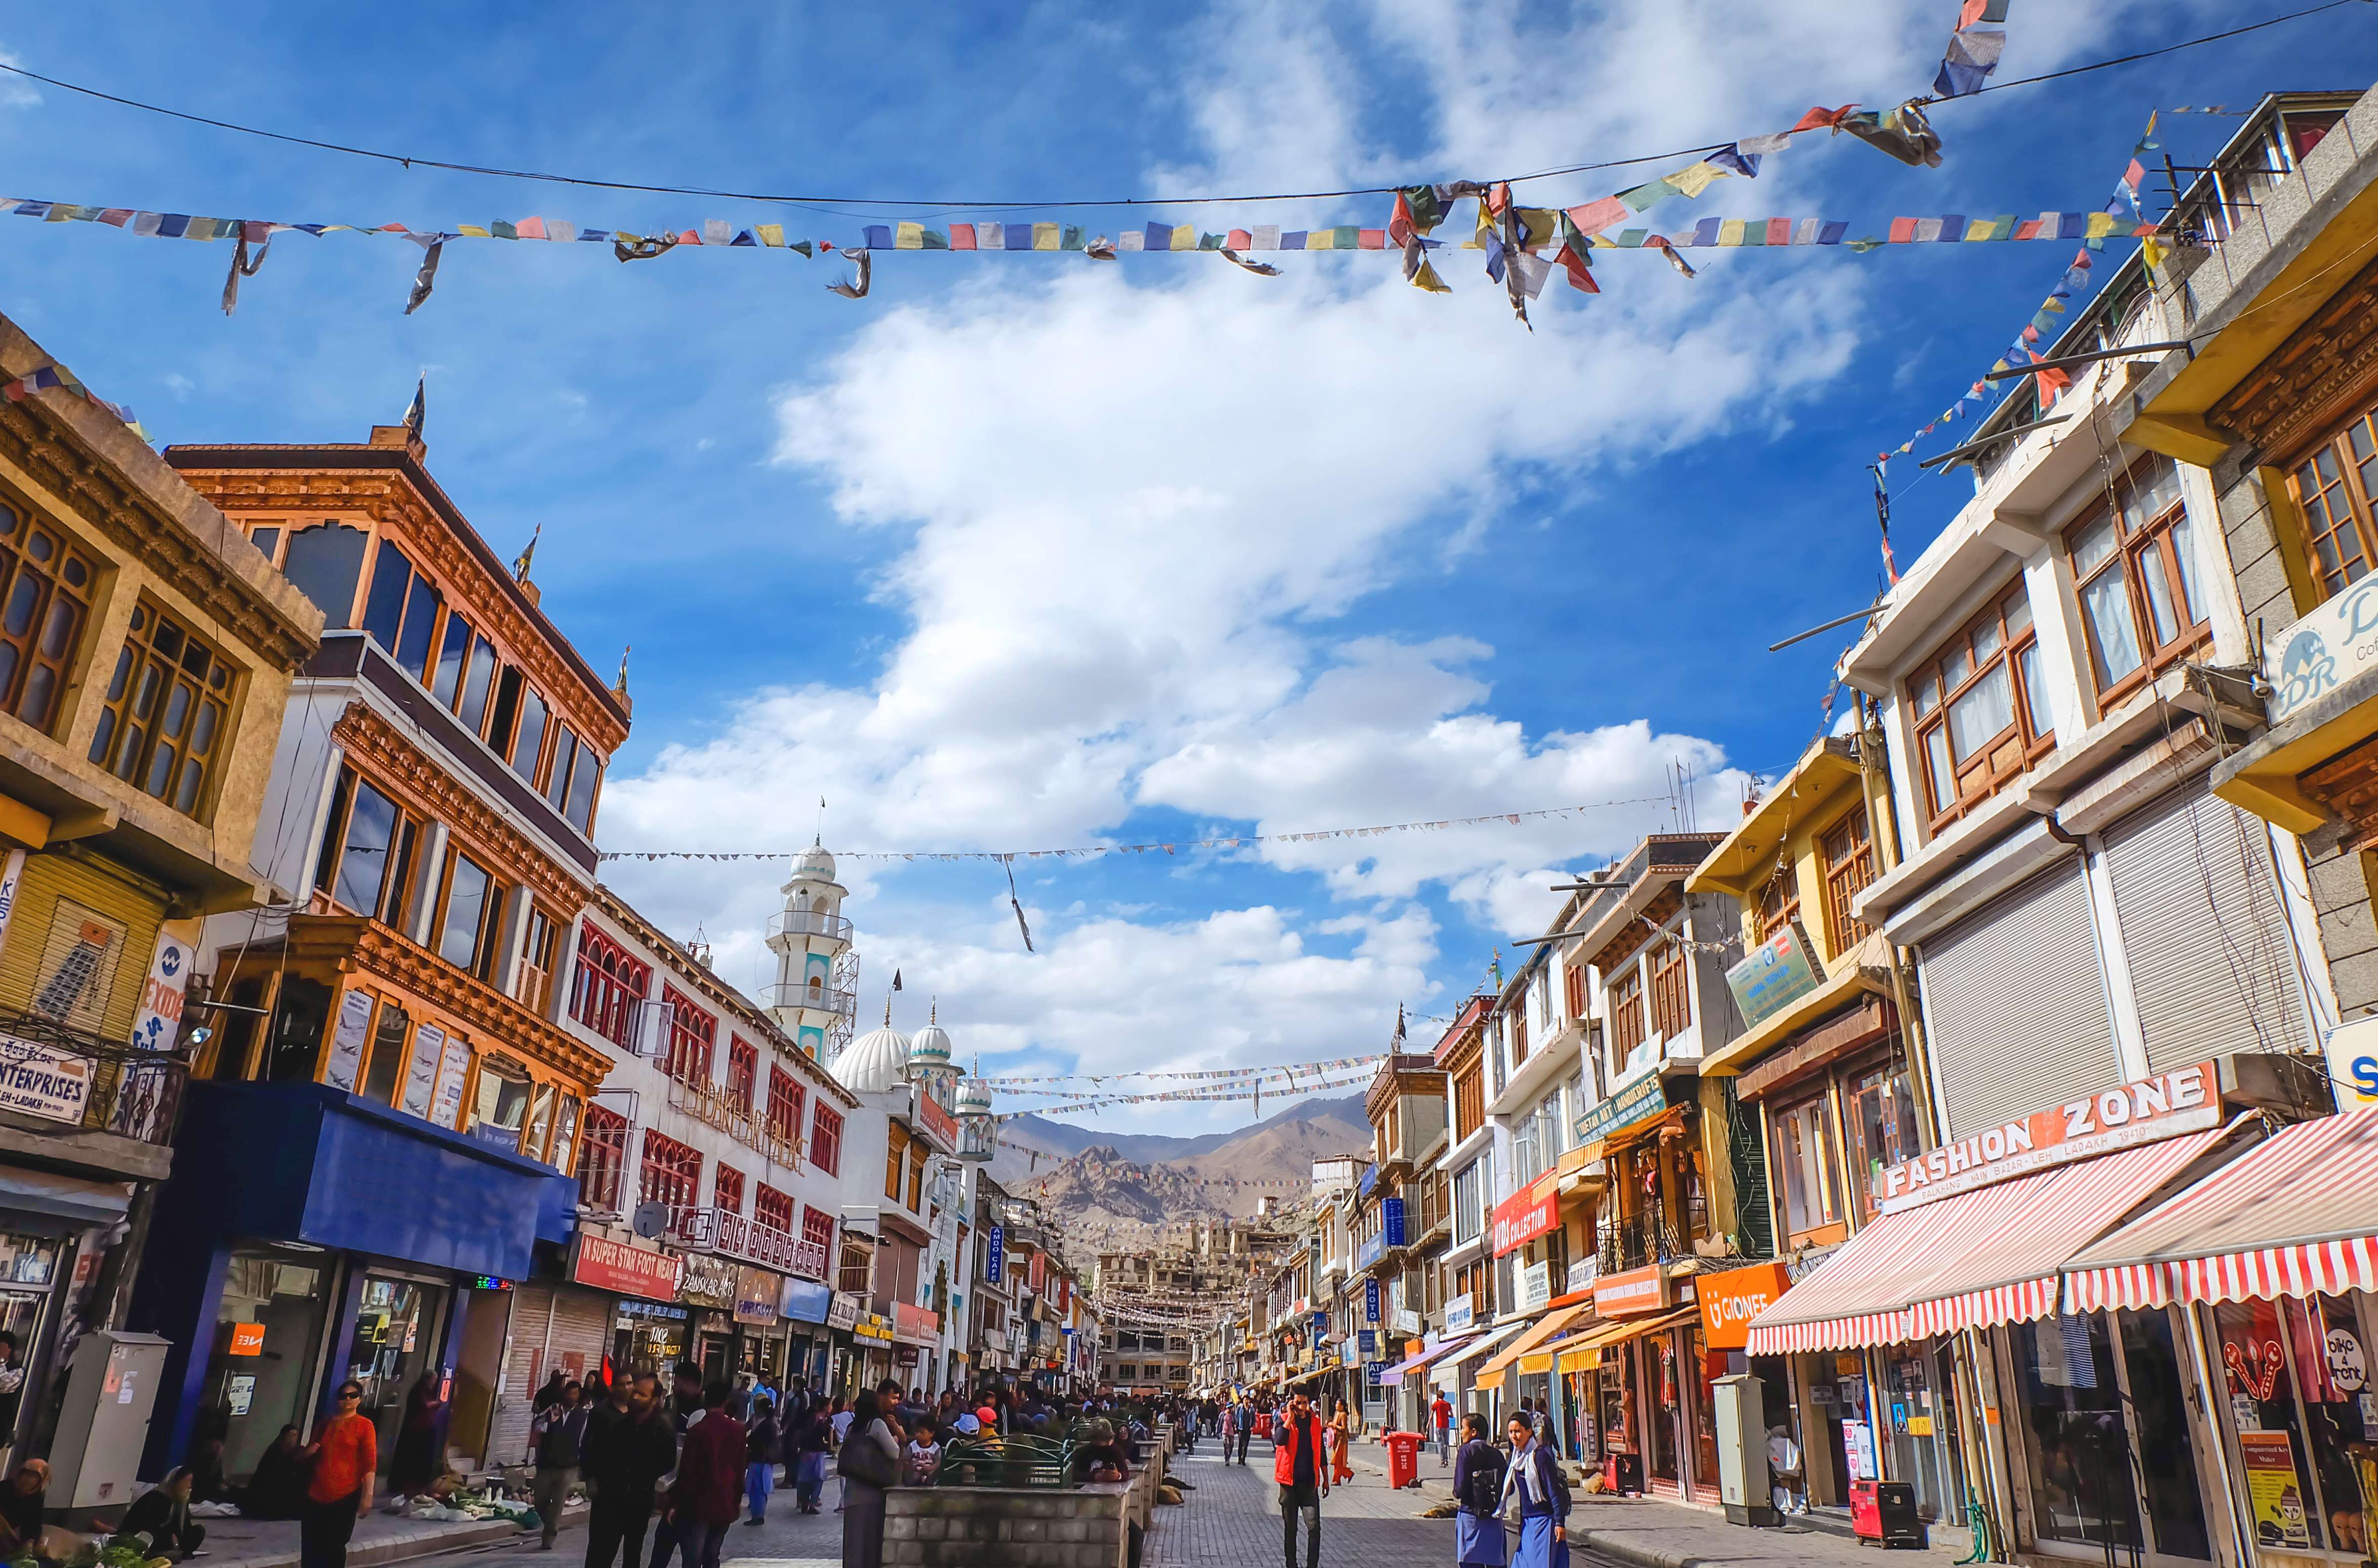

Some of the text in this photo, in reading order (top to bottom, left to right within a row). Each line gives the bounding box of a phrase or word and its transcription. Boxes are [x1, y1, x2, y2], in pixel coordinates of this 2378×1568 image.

[142, 977, 186, 1023] EXIDE
[0, 1092, 43, 1109] EH-LADAKH
[1577, 1113, 1599, 1136] TIBETAN
[1599, 1105, 1613, 1123] ART
[1616, 1073, 1660, 1111] HANDICRAFTS
[1885, 1066, 2206, 1198] FASHION ZONE
[2065, 1137, 2107, 1156] LADAKH
[992, 1228, 1000, 1252] AMDO
[1495, 1205, 1546, 1254] KIDS COLLECTION
[583, 1237, 591, 1259] N
[591, 1240, 617, 1266] SUPER
[618, 1247, 637, 1271] STAR
[636, 1252, 656, 1276] FOOT
[656, 1258, 675, 1281] WEAR
[683, 1273, 735, 1298] ZANSKAR ARTS
[1369, 1364, 1389, 1372] ATM
[2342, 1356, 2348, 1366] 4
